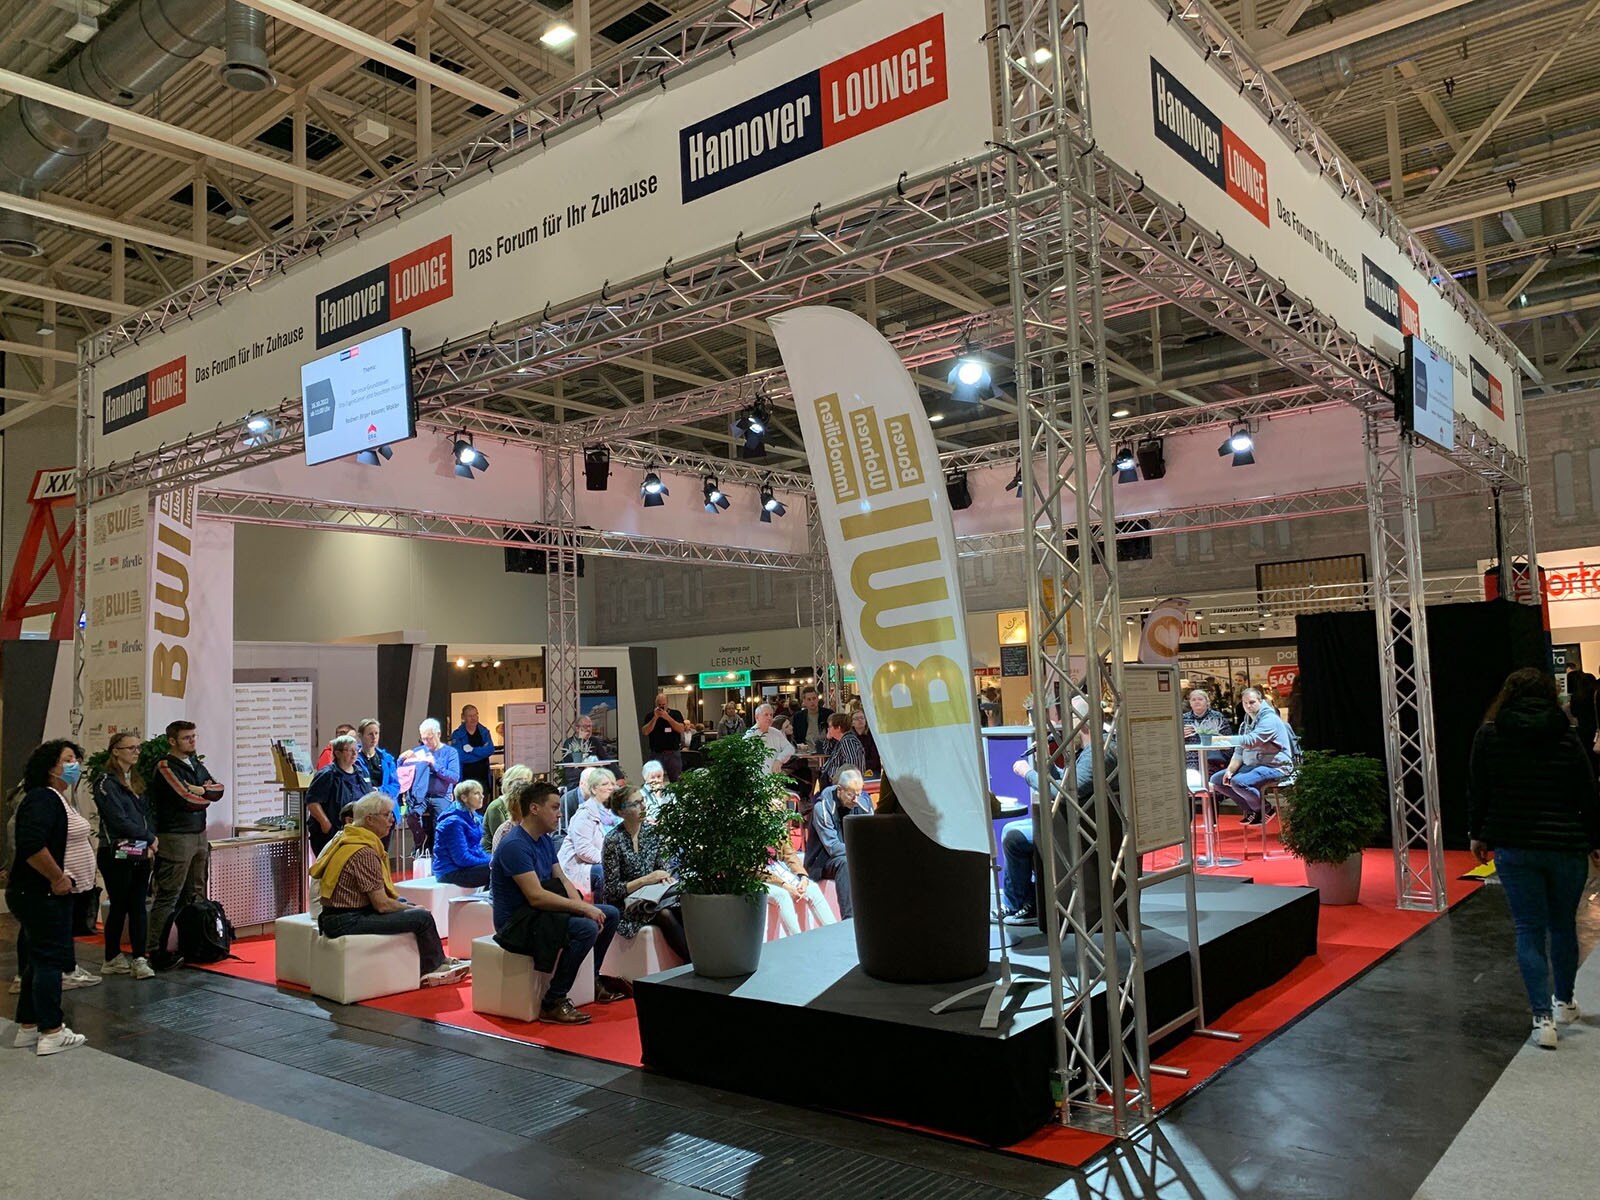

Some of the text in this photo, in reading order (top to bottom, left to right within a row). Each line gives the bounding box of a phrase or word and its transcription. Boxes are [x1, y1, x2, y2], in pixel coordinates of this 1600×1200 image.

[688, 40, 935, 182] Hannover LOUNGE
[1156, 72, 1265, 209] Hannover LOUNGE
[468, 174, 659, 270] Das Forum für Ihr Zuhause
[1277, 198, 1291, 227] Das
[1292, 211, 1314, 247] Forum
[1334, 248, 1358, 284] Zuhause
[319, 252, 448, 335] Hannover LOUNGE
[1364, 262, 1399, 319] Hannover
[195, 326, 304, 384] Das Forum für Ihr Zuhause
[105, 368, 184, 425] Hannover LOUNGE
[107, 507, 131, 535] BWI
[106, 591, 130, 617] BWI
[151, 523, 192, 699] BWI
[105, 677, 129, 702] BWI
[711, 655, 762, 667] LEBENSART
